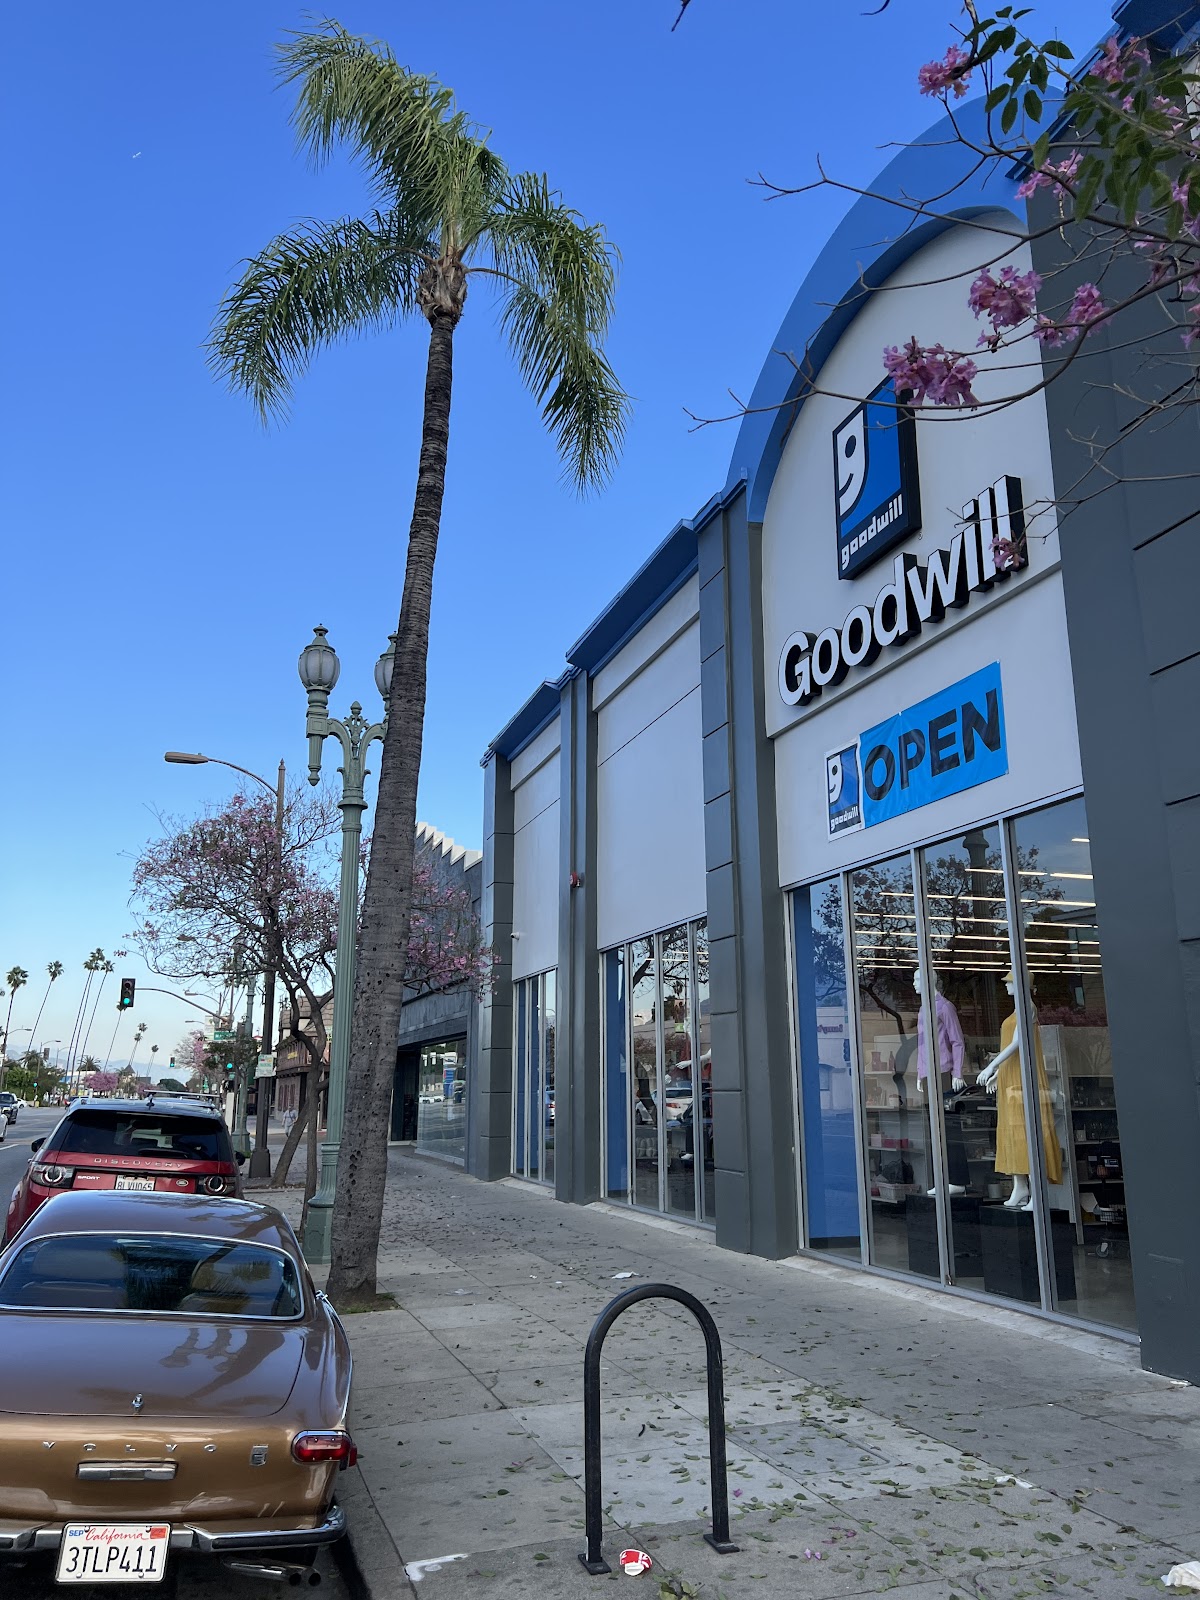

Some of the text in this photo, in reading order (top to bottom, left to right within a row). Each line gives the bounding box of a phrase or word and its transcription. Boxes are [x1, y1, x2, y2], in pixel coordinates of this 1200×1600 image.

[841, 494, 903, 571] goodwill
[778, 475, 1015, 706] Goodwill
[864, 688, 1002, 801] OPEN
[830, 806, 859, 832] goodwill
[94, 1158, 181, 1168] DISCOVERY
[42, 1441, 217, 1452] VOLVO
[69, 1529, 84, 1537] SEP
[86, 1528, 149, 1545] California
[66, 1545, 157, 1573] 3TLP411
